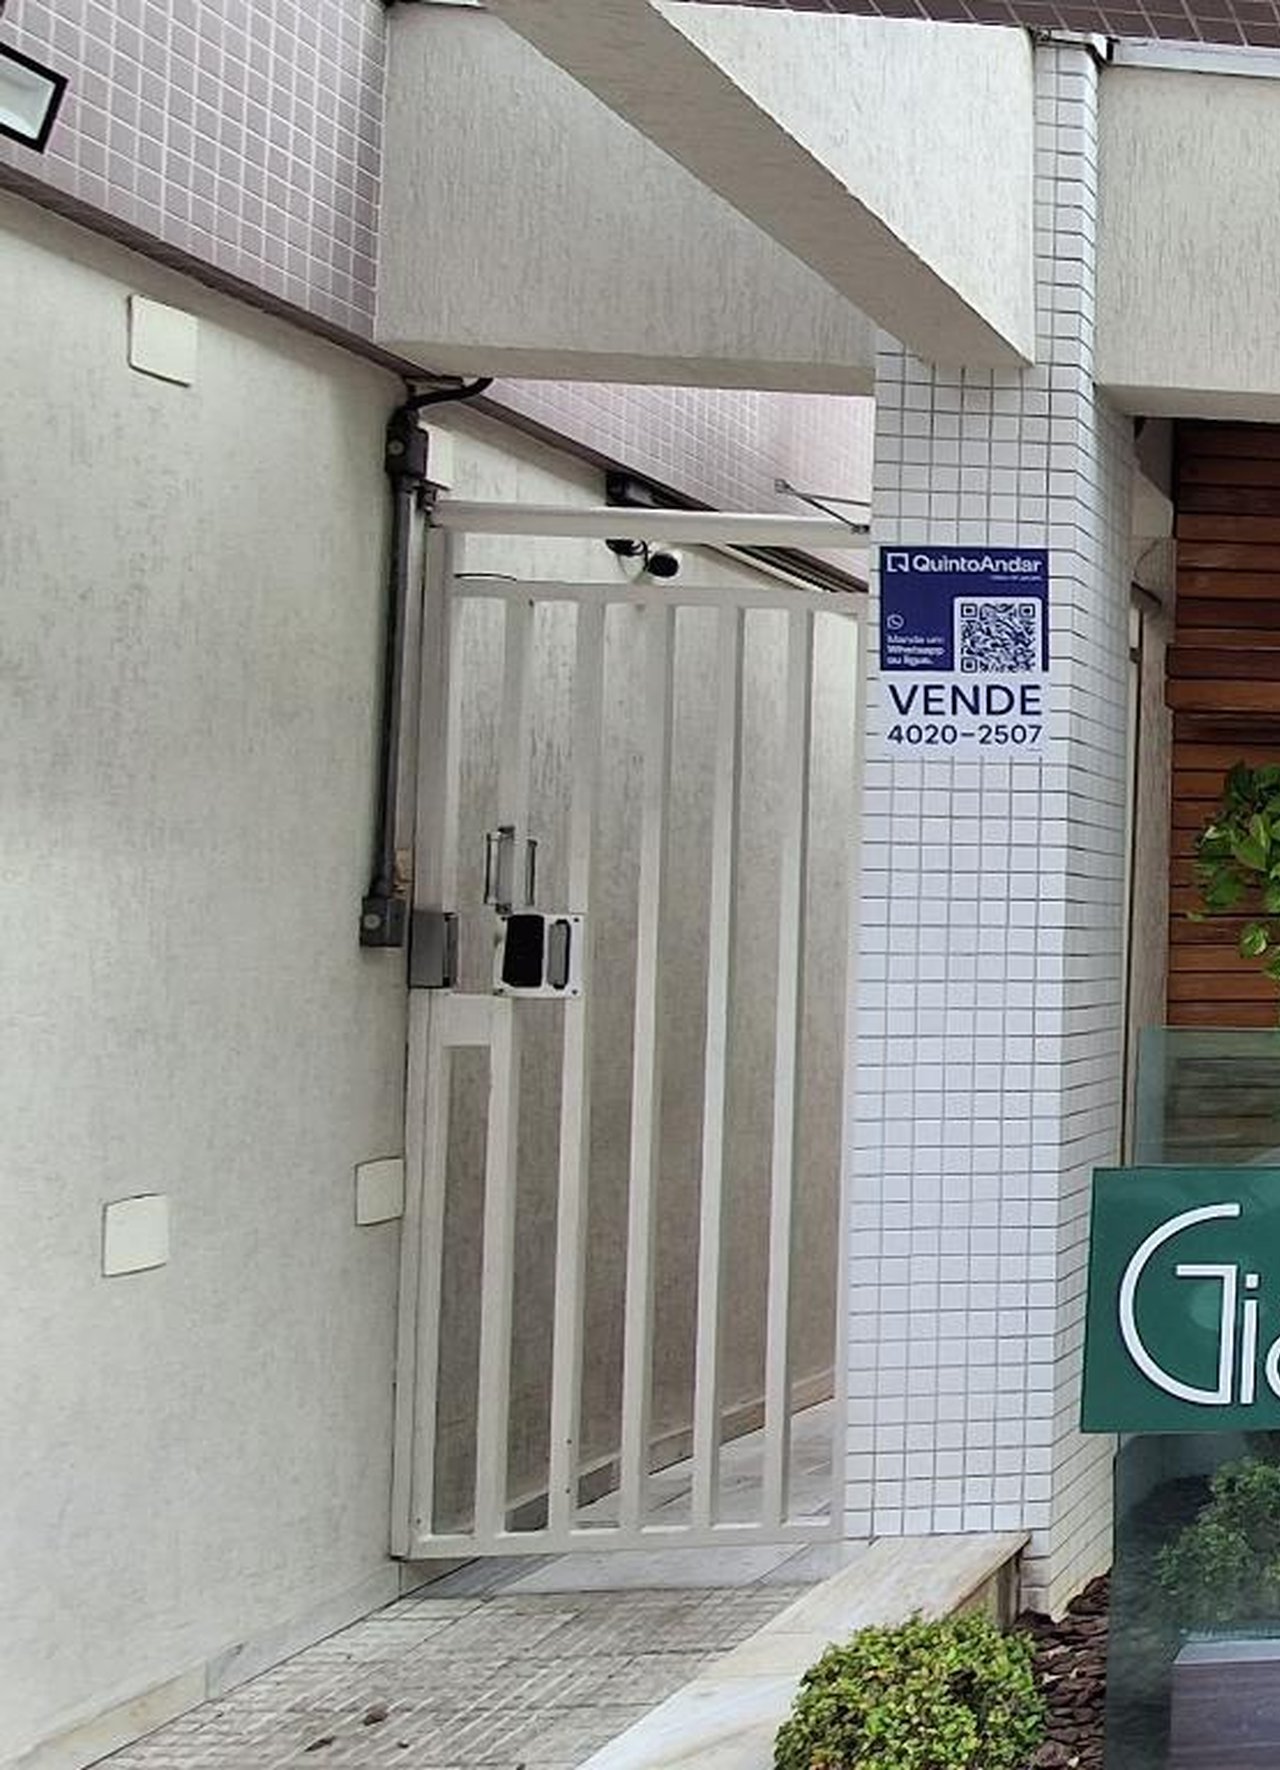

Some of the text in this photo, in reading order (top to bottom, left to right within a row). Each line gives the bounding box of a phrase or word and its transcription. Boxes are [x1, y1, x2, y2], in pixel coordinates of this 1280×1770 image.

[912, 554, 1042, 572] QuintoAndar
[888, 684, 1042, 716] VENDE
[887, 724, 1043, 745] 4020-2507
